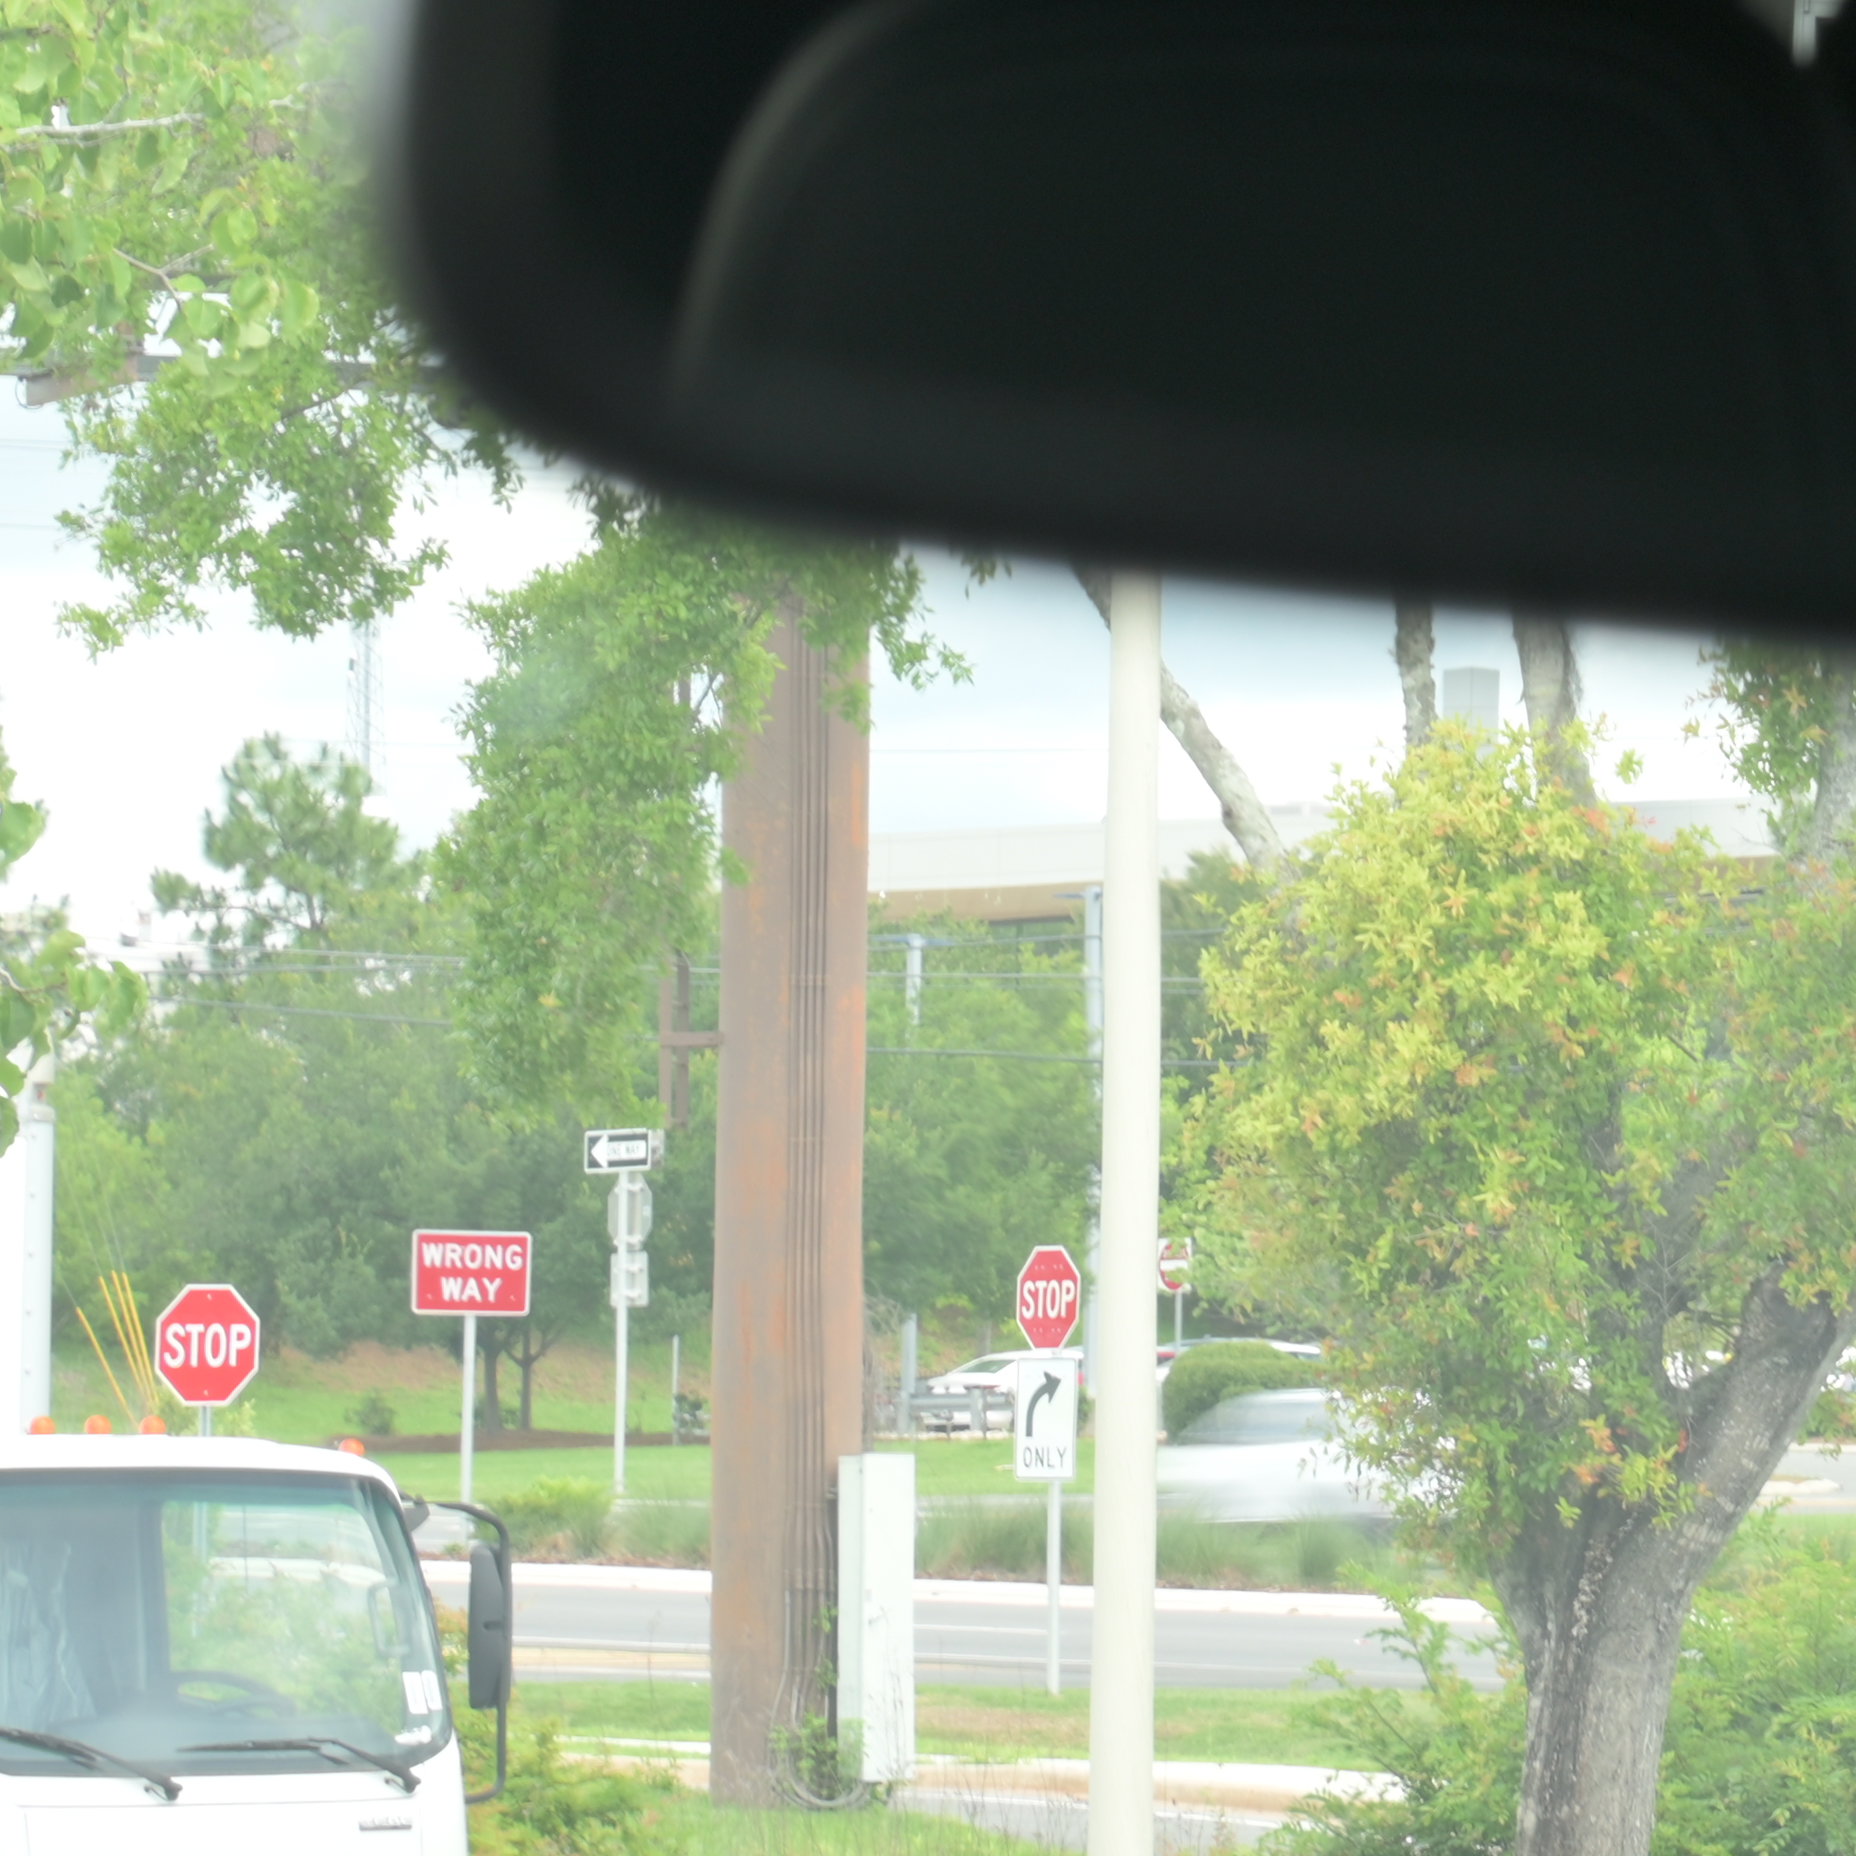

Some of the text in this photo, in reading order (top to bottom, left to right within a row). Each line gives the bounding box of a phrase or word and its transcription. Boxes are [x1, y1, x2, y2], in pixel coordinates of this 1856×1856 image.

[421, 1242, 523, 1271] WRONG
[440, 1276, 503, 1303] WAY
[1021, 1279, 1076, 1319] STOP
[163, 1322, 252, 1369] STOP
[1022, 1446, 1067, 1469] ONLY
